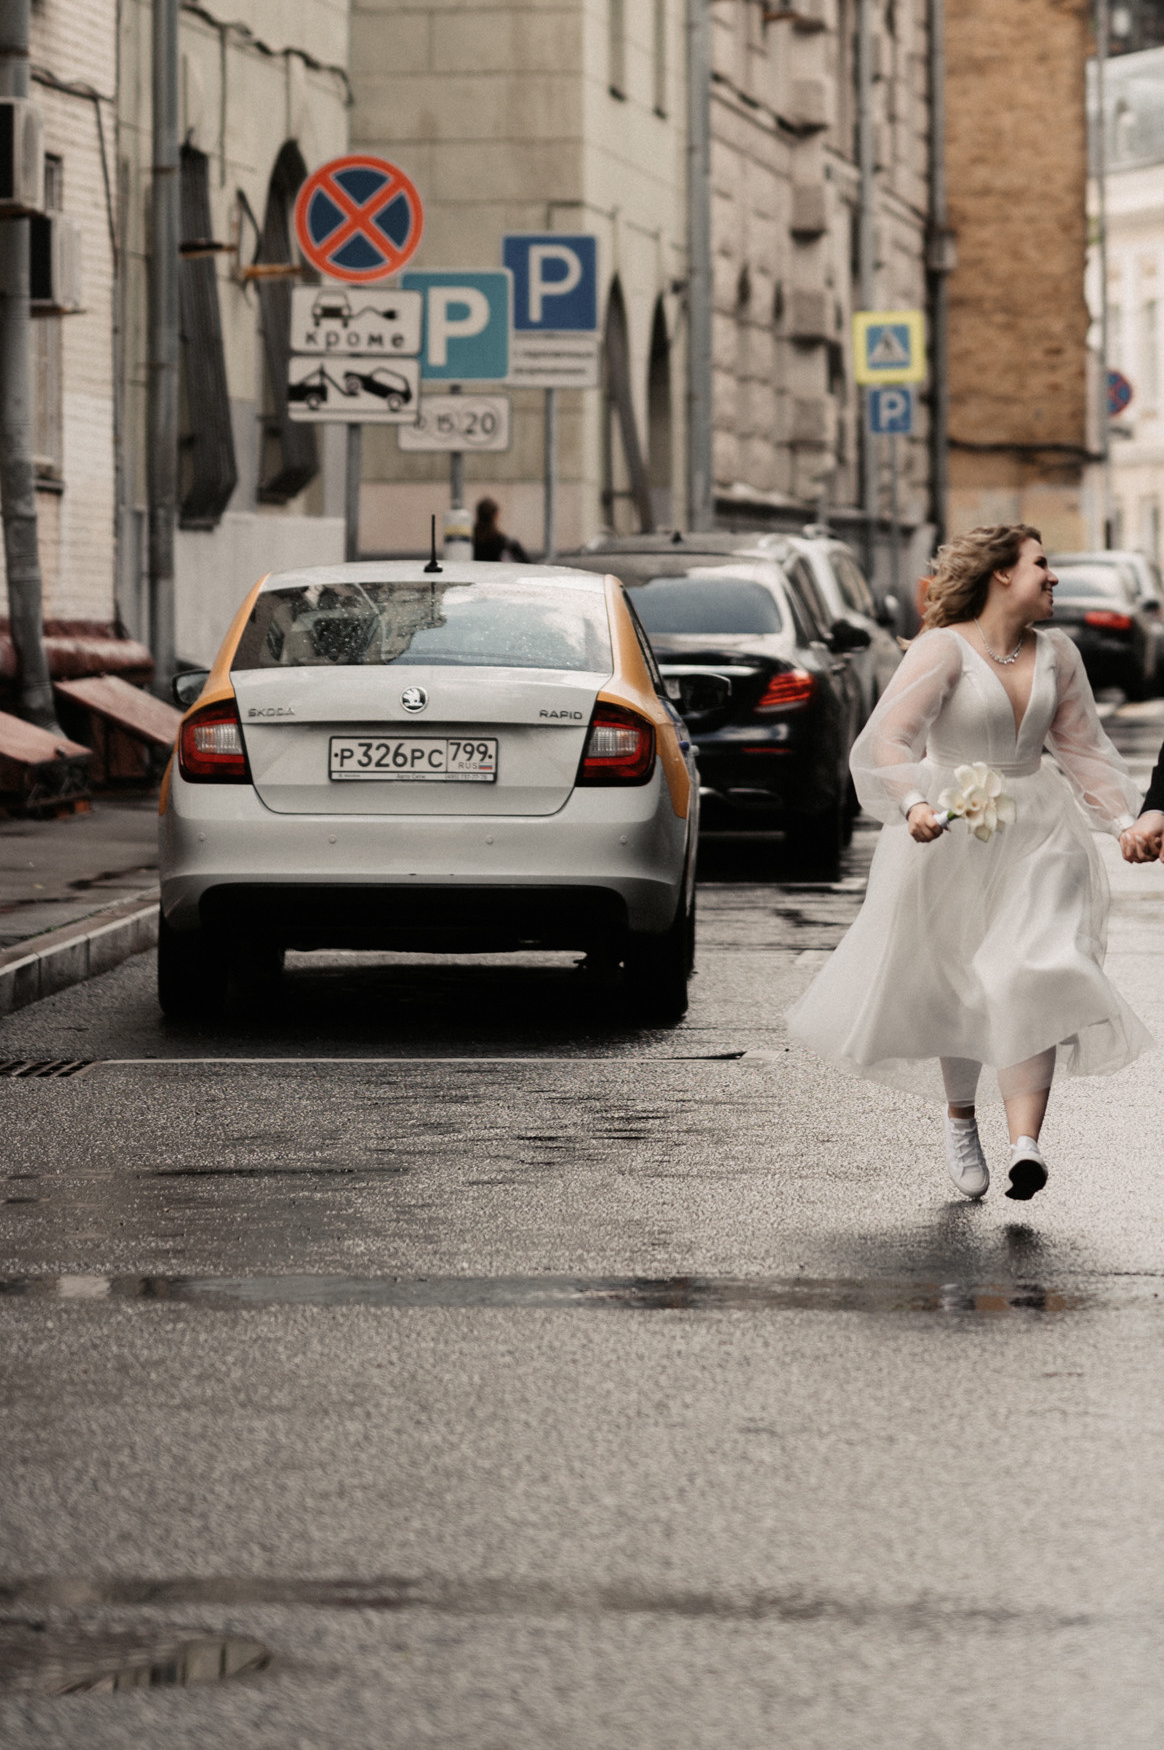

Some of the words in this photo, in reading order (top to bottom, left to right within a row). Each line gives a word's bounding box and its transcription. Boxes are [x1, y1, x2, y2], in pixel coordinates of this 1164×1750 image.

[528, 244, 581, 323] P
[427, 286, 490, 367] P
[305, 331, 404, 350] кроме
[880, 390, 906, 429] P
[464, 412, 495, 435] 20
[539, 709, 583, 720] RAPID
[449, 742, 489, 762] 799
[458, 761, 478, 770] RUS
